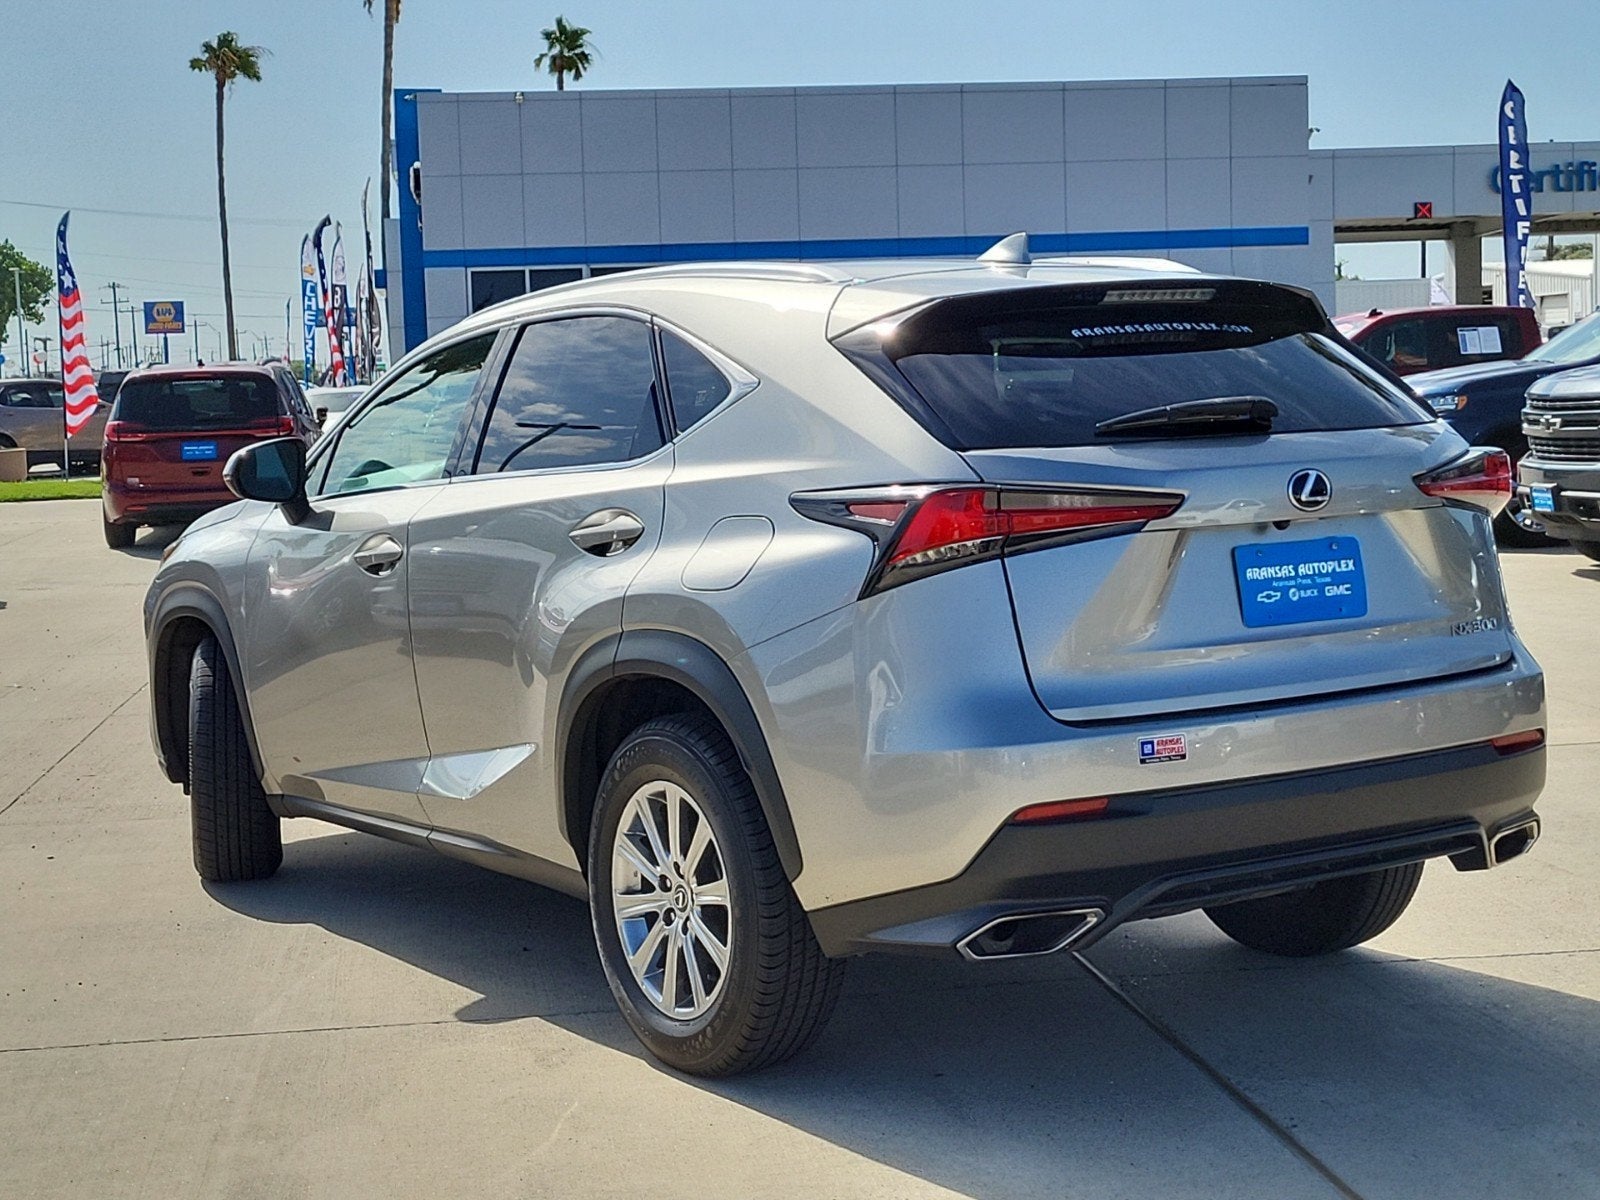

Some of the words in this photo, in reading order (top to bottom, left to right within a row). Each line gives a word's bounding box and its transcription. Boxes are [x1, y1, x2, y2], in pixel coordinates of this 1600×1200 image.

[1491, 161, 1600, 194] rtifi
[1246, 565, 1295, 580] ARANSAS
[1298, 559, 1355, 575] AUTOPLEX
[1325, 584, 1352, 597] GMC
[1451, 618, 1498, 637] NX300
